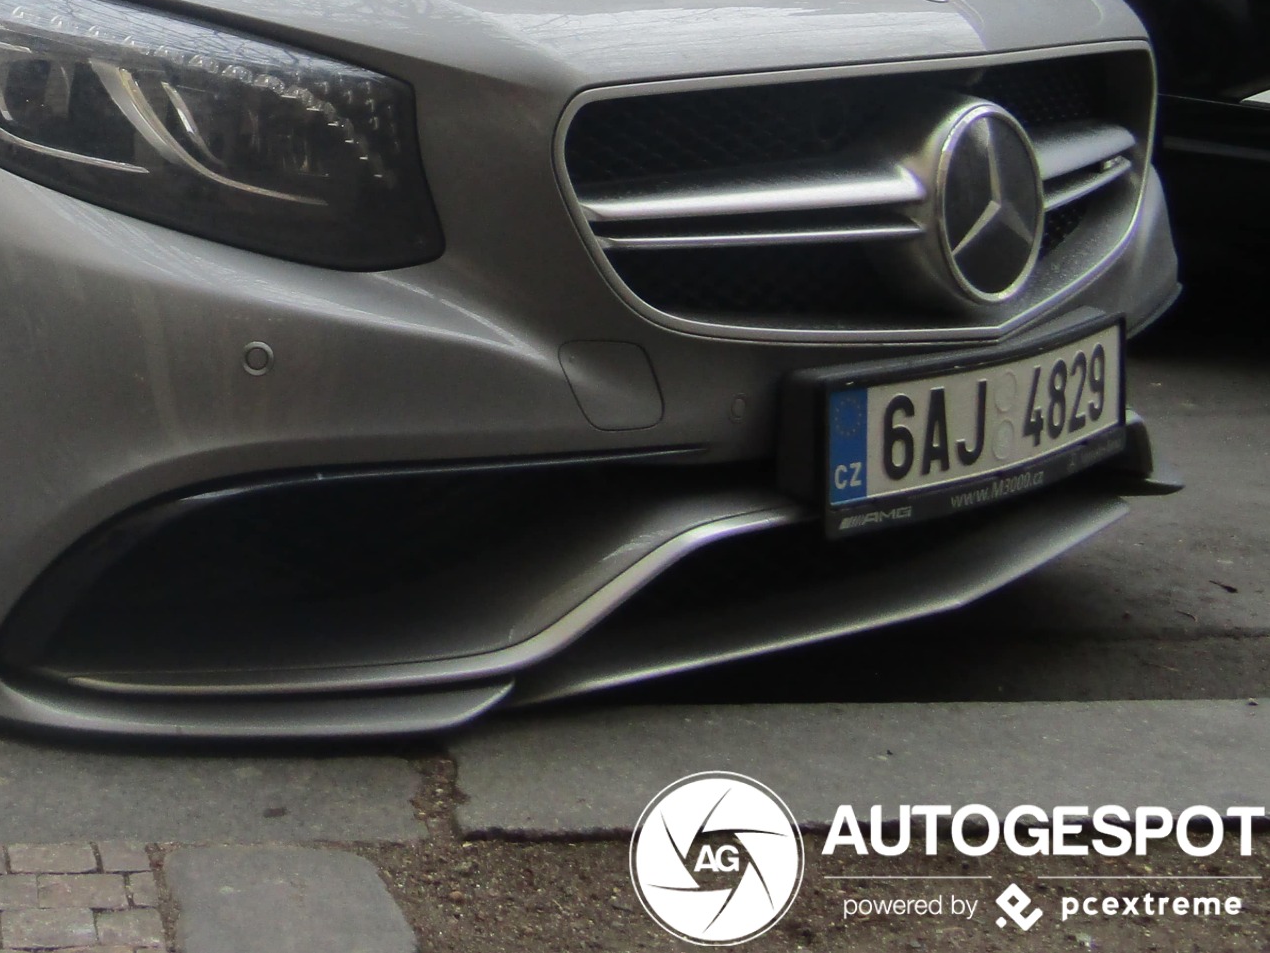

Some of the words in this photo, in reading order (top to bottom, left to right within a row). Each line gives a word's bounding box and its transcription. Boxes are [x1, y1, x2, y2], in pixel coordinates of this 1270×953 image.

[882, 378, 988, 481] 6AJ
[1023, 342, 1106, 447] 4829
[834, 461, 863, 490] CZ
